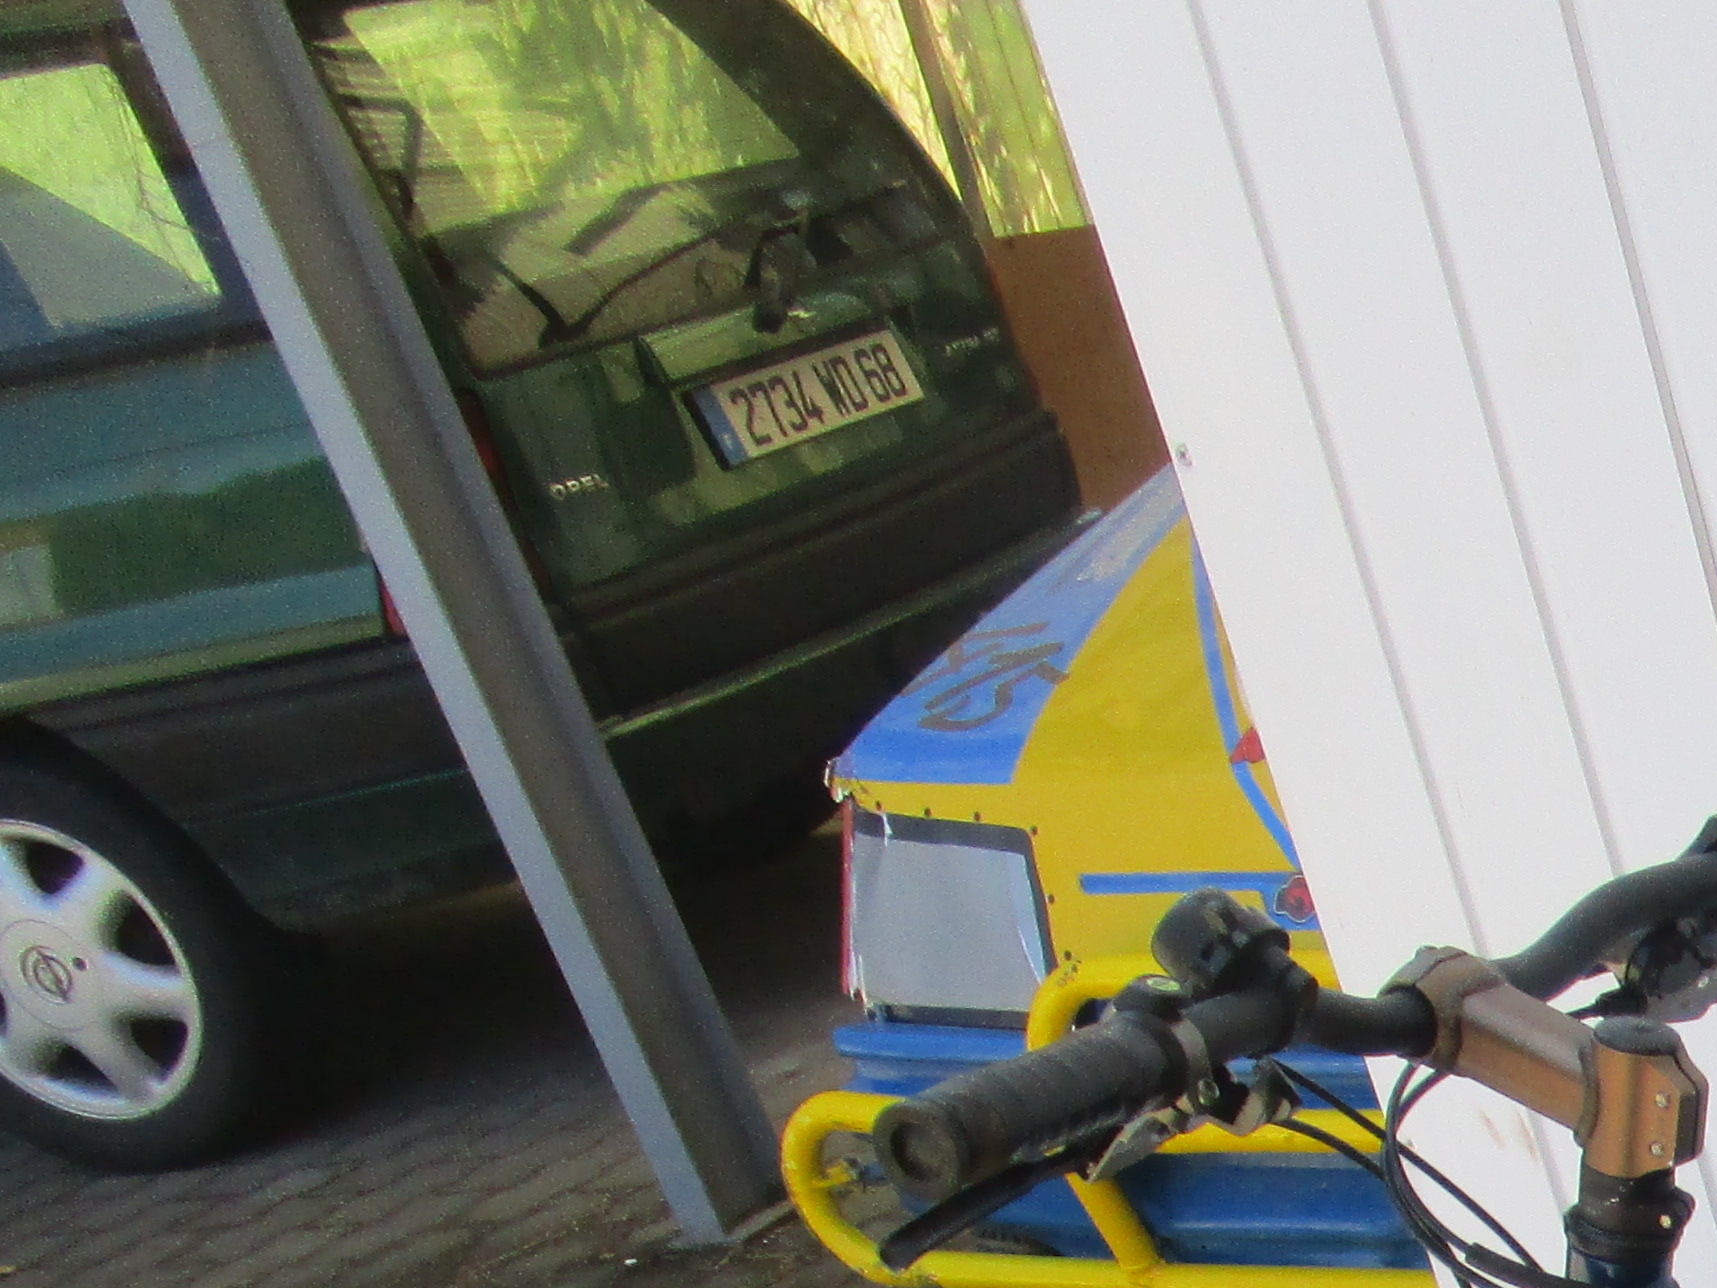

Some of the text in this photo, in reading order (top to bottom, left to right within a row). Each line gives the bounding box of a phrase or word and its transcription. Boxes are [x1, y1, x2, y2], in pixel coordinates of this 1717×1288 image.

[729, 369, 825, 446] 2734
[855, 343, 907, 402] 68
[548, 473, 610, 501] OPEL
